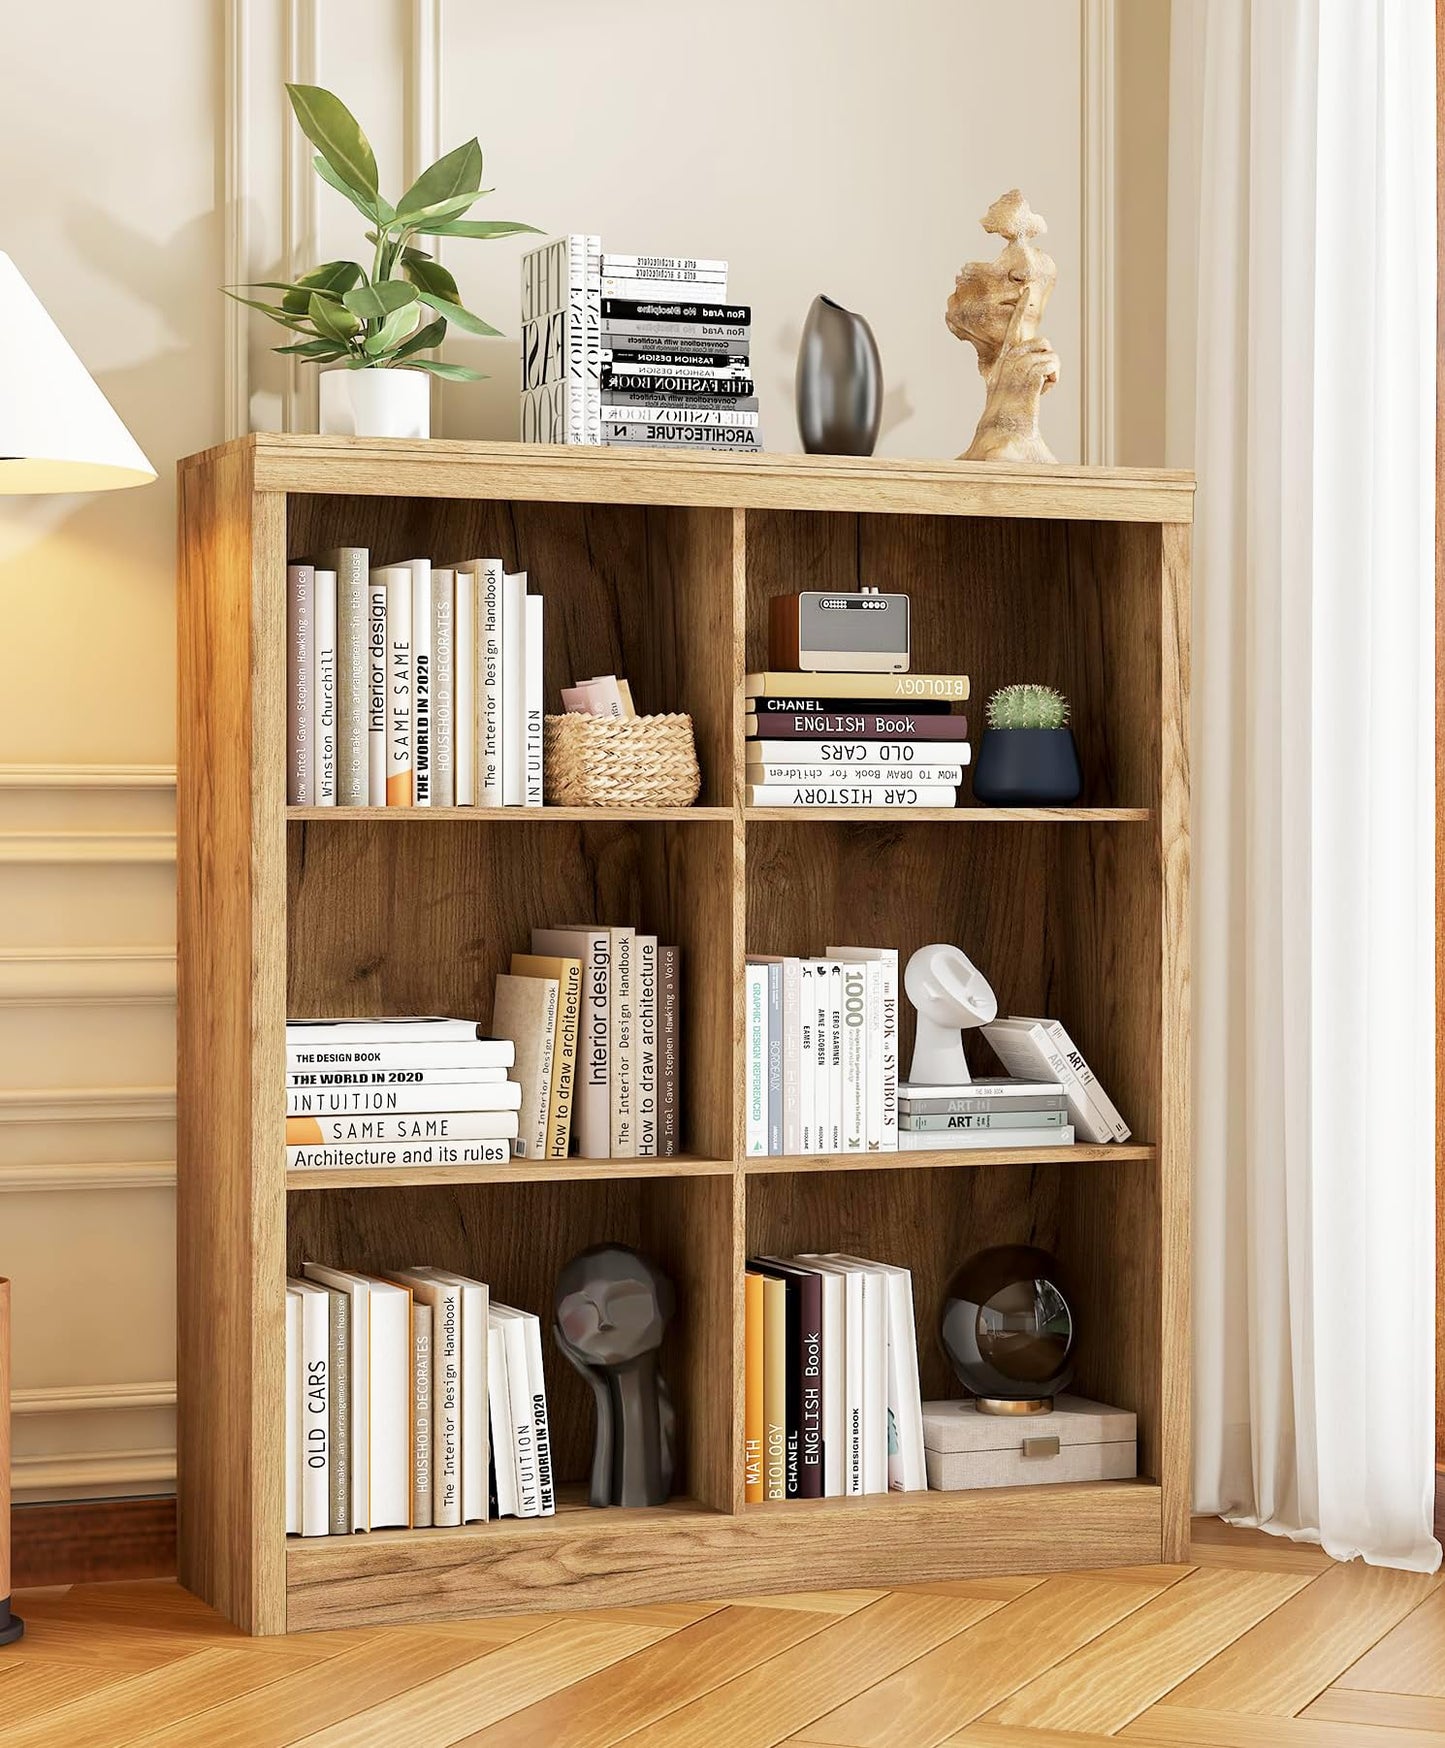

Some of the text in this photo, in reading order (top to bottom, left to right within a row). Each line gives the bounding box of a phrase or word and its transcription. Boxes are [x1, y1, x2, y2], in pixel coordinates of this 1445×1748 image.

[296, 570, 306, 602] Voice
[296, 619, 308, 663] Hawking
[368, 593, 387, 732] Interior design
[296, 669, 308, 711] Stephen
[350, 552, 362, 798] How to make an arrangement in the house
[437, 601, 450, 771] HOUSEHOLD DECORATES
[484, 569, 498, 788] The Interior Design Handbook
[895, 679, 963, 695] BIOLOGY
[321, 649, 333, 797] Winston Churchill
[394, 641, 409, 761] SAME SAME
[767, 700, 824, 711] CHANEL
[297, 717, 306, 742] Gave
[416, 655, 429, 801] THE WORLD IN 2020
[794, 716, 916, 733] ENGLISH Book
[296, 747, 306, 778] Intel
[528, 710, 541, 802] INTUITION
[769, 768, 958, 780] HOW TO DRAW Book for children
[821, 745, 914, 761] OLD CARS
[297, 784, 306, 802] How
[793, 788, 918, 804] CAR HISTORY
[665, 950, 674, 979] Voice
[589, 940, 611, 1085] Interior design
[664, 993, 676, 1034] Hawking
[845, 971, 864, 1028] 1000
[884, 998, 895, 1039] BOOK
[296, 1052, 381, 1063] THE DESIGN BOOK
[618, 936, 632, 1145] The Interior Design Handbook
[639, 944, 654, 1156] How to draw architecture
[664, 1037, 676, 1075] Stephen
[752, 982, 761, 1122] GRAPHIC DESIGN REFERENCED
[803, 1025, 811, 1050] EAMES
[817, 1008, 825, 1066] ARNE JACOBSEN
[832, 1010, 840, 1066] EERO SAARINEN
[292, 1072, 424, 1085] THE WORLD IN 2020
[536, 986, 556, 1148] The Interior Design Handbook
[551, 966, 580, 1157] How to draw architecture
[770, 1040, 780, 1092] BORDEAUX
[1048, 1053, 1067, 1074] ART
[1066, 1051, 1086, 1072] ART
[294, 1092, 397, 1111] INTUITION
[664, 1080, 674, 1103] Gave
[884, 1054, 895, 1126] SYMBOLS
[947, 1101, 974, 1112] ART
[333, 1120, 449, 1139] SAME SAME
[664, 1107, 674, 1137] Intel
[947, 1116, 972, 1128] ART
[294, 1145, 504, 1167] Architecture and its rules
[665, 1140, 674, 1157] How
[308, 1360, 326, 1468] OLD CARS
[337, 1299, 346, 1525] How to make an arrangement in the house
[416, 1336, 428, 1493] HOUSEHOLD DECORATES
[443, 1296, 457, 1507] The Interior Design Handbook
[804, 1332, 820, 1465] ENGLISH Book
[517, 1425, 536, 1511] INTUITION
[533, 1394, 553, 1511] THE WORLD IN 2020
[746, 1439, 761, 1484] MATH
[768, 1423, 783, 1499] BIOLOGY
[788, 1430, 798, 1493] CHANEL
